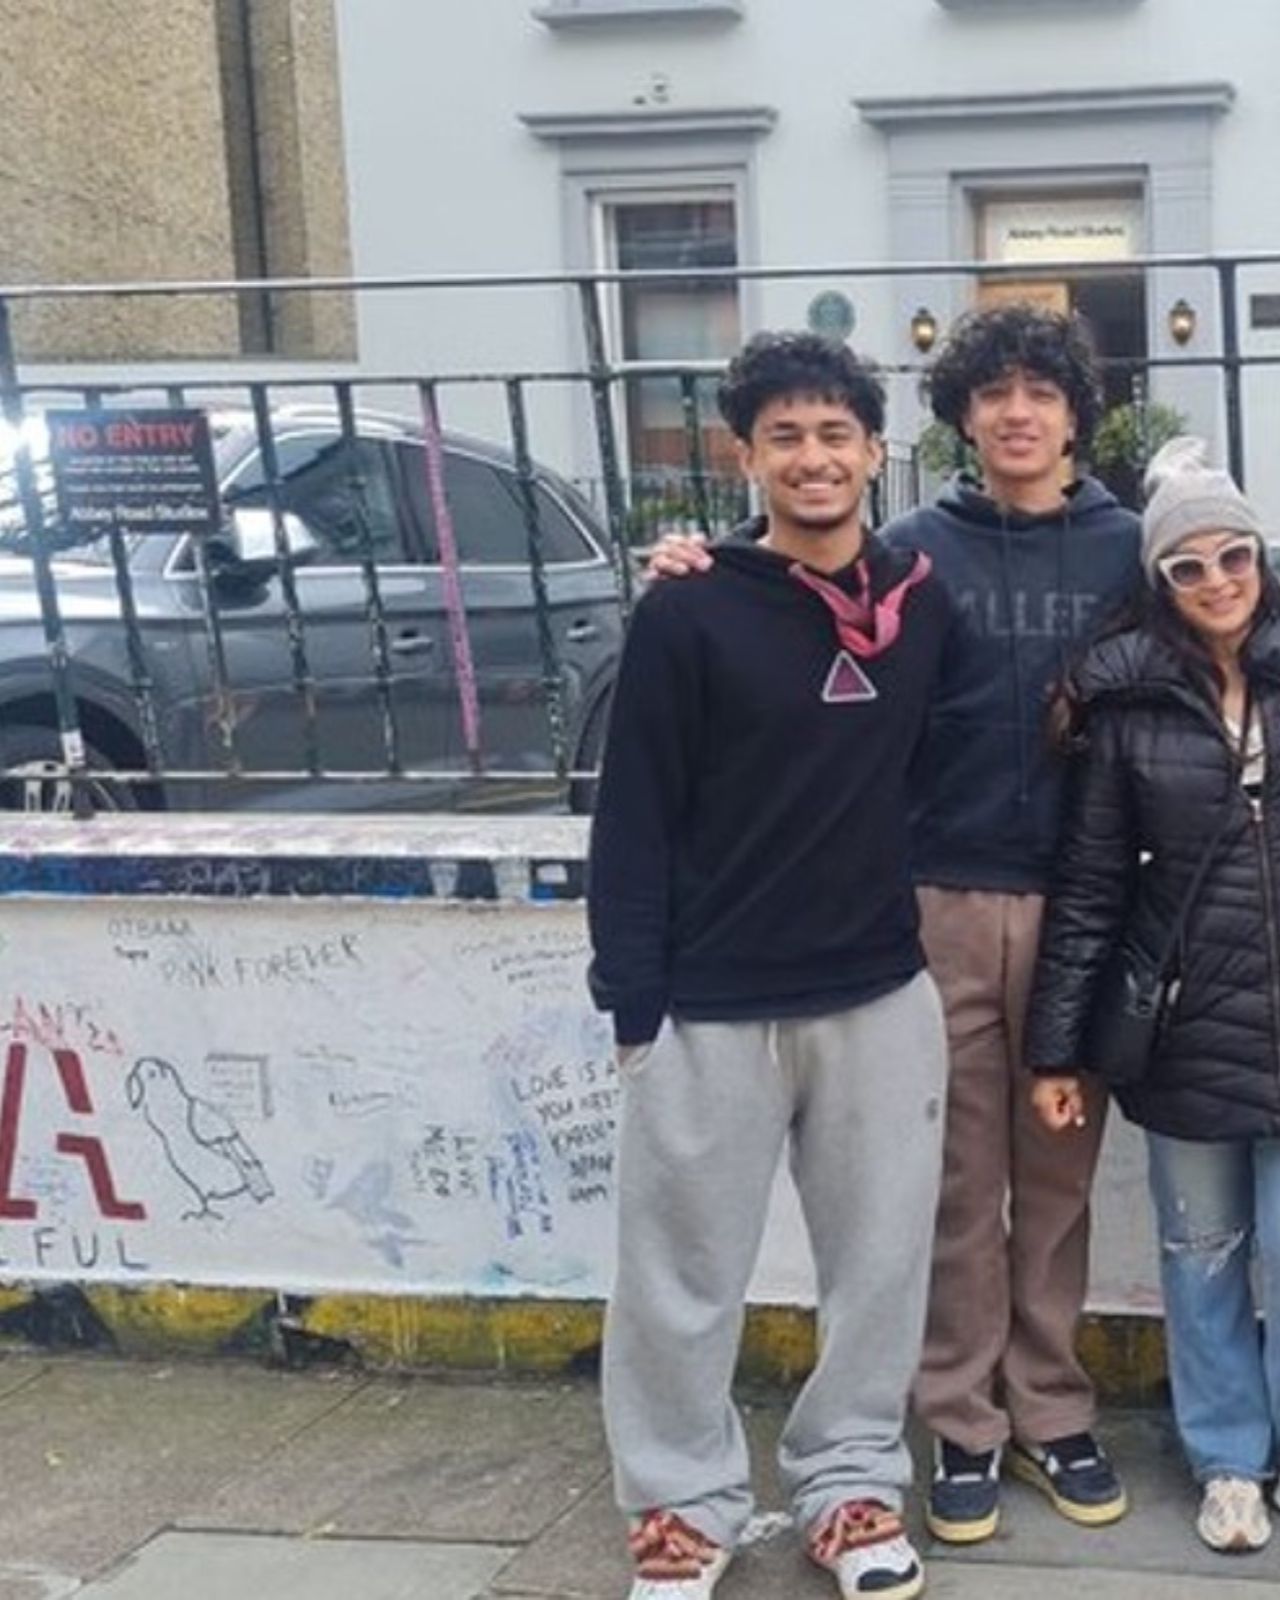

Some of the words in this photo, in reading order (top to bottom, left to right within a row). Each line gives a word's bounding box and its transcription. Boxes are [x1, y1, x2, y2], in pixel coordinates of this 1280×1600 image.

[60, 424, 97, 448] NO
[105, 422, 196, 448] ENTRY
[233, 933, 365, 985] FOREVER
[535, 1097, 573, 1126] YOU
